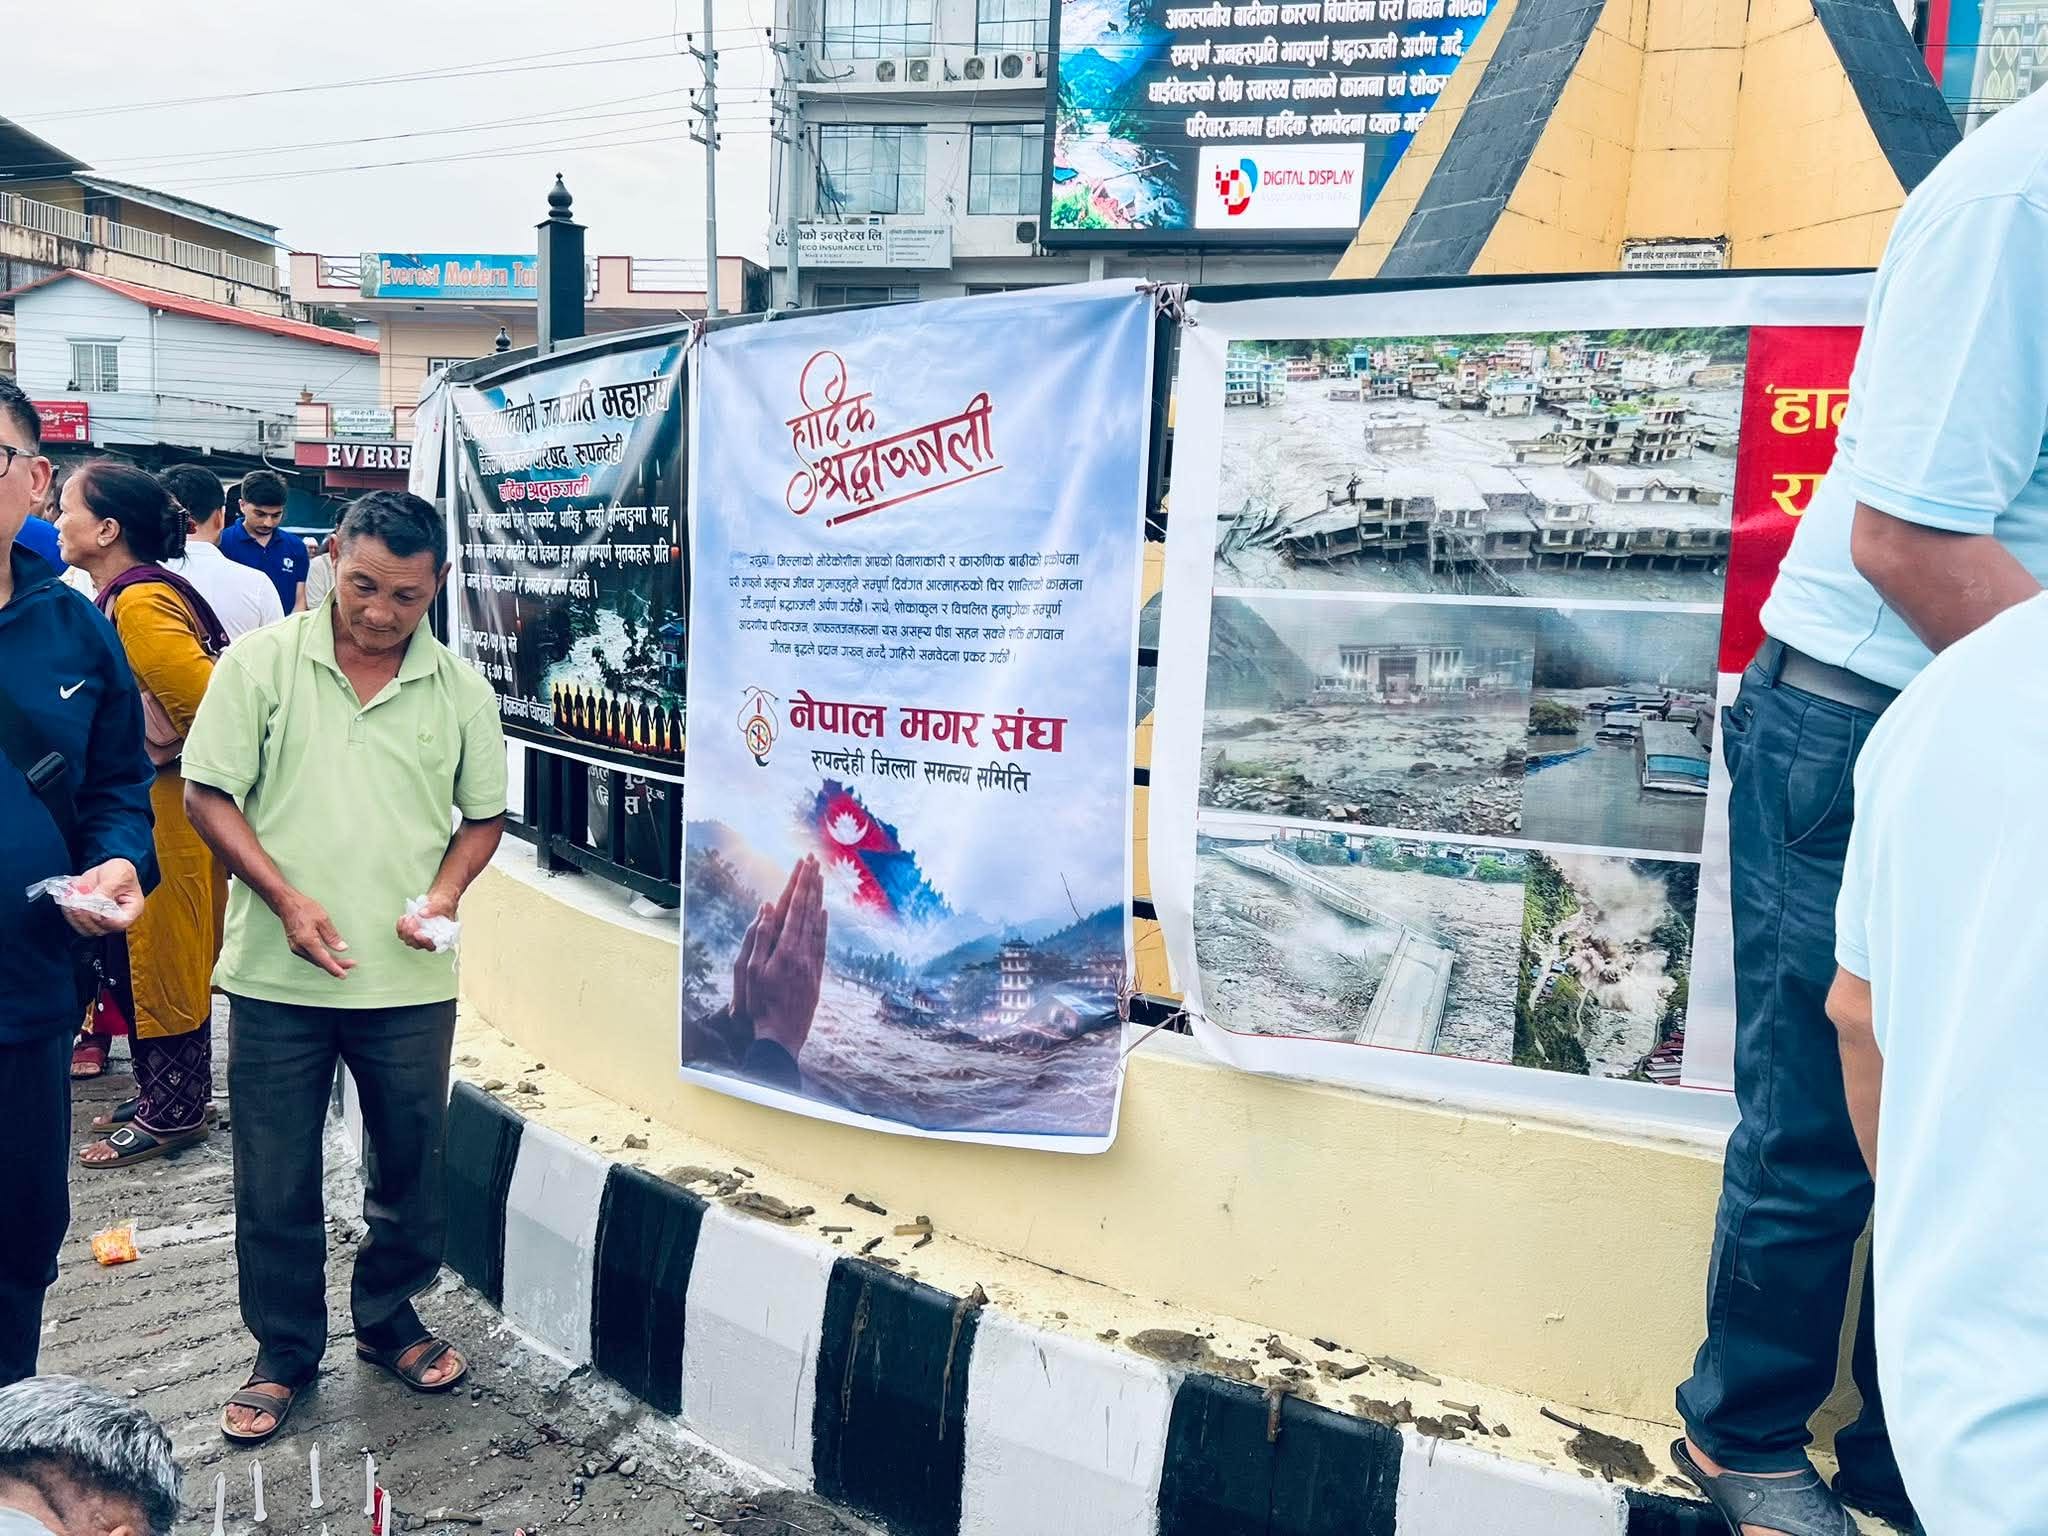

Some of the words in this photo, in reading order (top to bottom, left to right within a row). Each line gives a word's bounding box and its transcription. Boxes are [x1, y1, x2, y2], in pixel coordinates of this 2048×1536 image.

[1165, 1, 1232, 29] अकल्पनीय
[1281, 4, 1321, 25] कारण
[1401, 30, 1438, 58] अर्पण
[1246, 79, 1290, 101] स्वास्थ्य
[1292, 71, 1338, 100] लाभको
[1340, 76, 1385, 97] कामना
[1388, 70, 1407, 96] एवं
[1266, 109, 1307, 138] हार्दिक
[1310, 109, 1367, 136] समवेदना
[1369, 113, 1401, 133] व्यक्त
[1264, 170, 1304, 185] DIGITAL
[1309, 169, 1354, 185] DISPLAY
[382, 260, 440, 287] Everest
[444, 260, 508, 287] Modern
[540, 379, 596, 429] जनजाति
[600, 369, 673, 417] महासंघ
[813, 392, 993, 504] श्रद्धाञ्जली
[499, 478, 525, 501] हार्दिक
[777, 553, 813, 567] जिल्लाको
[865, 553, 892, 567] आएको
[896, 553, 945, 567] विनाशकारी
[949, 555, 955, 567] र
[959, 553, 1004, 567] कारुणिक
[1009, 552, 1041, 567] बाढीको
[793, 576, 814, 588] जीवन
[892, 577, 922, 591] दिवंगत
[987, 577, 1003, 591] चिर
[1008, 577, 1043, 591] शान्तिको
[1046, 578, 1083, 591] कामना
[818, 597, 837, 612] अर्पण
[895, 599, 938, 617] शोकाकुल
[942, 604, 948, 615] र
[951, 601, 988, 615] विचलित
[1032, 600, 1063, 619] सम्पूर्ण
[882, 625, 897, 637] यस
[956, 628, 978, 640] सहन
[1026, 628, 1064, 640] भगवान
[818, 645, 838, 656] प्रदान
[866, 644, 885, 659] भन्दै
[889, 645, 915, 660] गहिरो
[919, 646, 960, 662] समवेदना
[963, 651, 985, 663] प्रकट
[789, 690, 887, 738] नेपाल
[900, 708, 984, 748] मगर
[992, 708, 1068, 752] संघ
[811, 747, 865, 776] रुपन्देही
[871, 749, 917, 779] जिल्ला
[924, 760, 973, 785] समन्वय
[977, 761, 1031, 793] समिति
